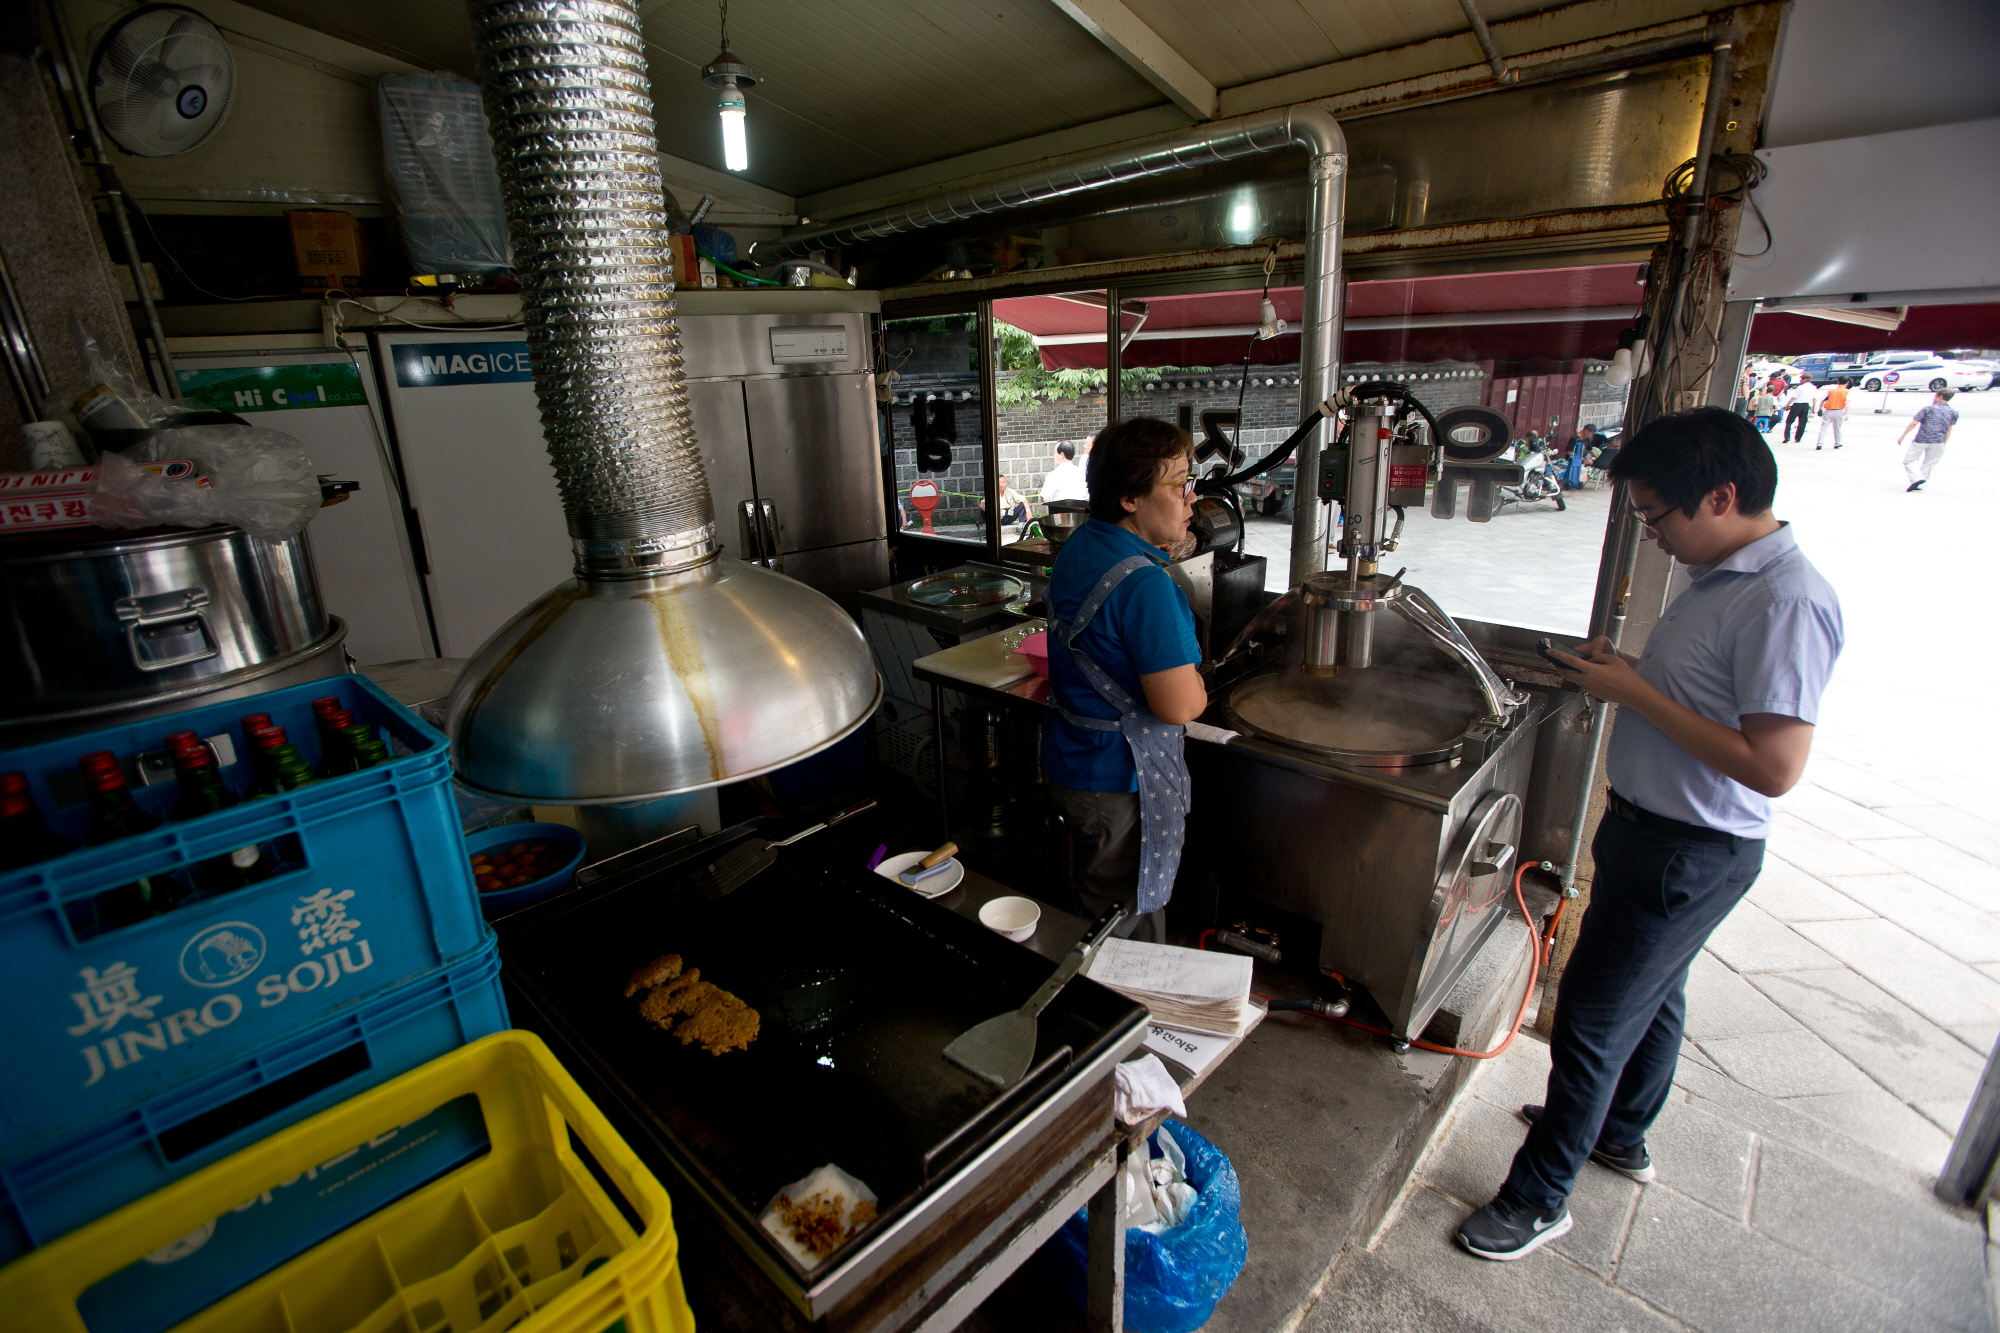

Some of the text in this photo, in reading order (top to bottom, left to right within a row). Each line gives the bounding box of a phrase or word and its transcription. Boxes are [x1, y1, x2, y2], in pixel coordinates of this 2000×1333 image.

[421, 352, 532, 376] MAGICE
[234, 388, 263, 407] Hi
[273, 385, 326, 405] Cool
[31, 472, 74, 486] JIN
[0, 500, 87, 525] 진쿠킹
[80, 939, 374, 1087] JINRO SOJU
[1151, 1026, 1199, 1054] 유진식당
